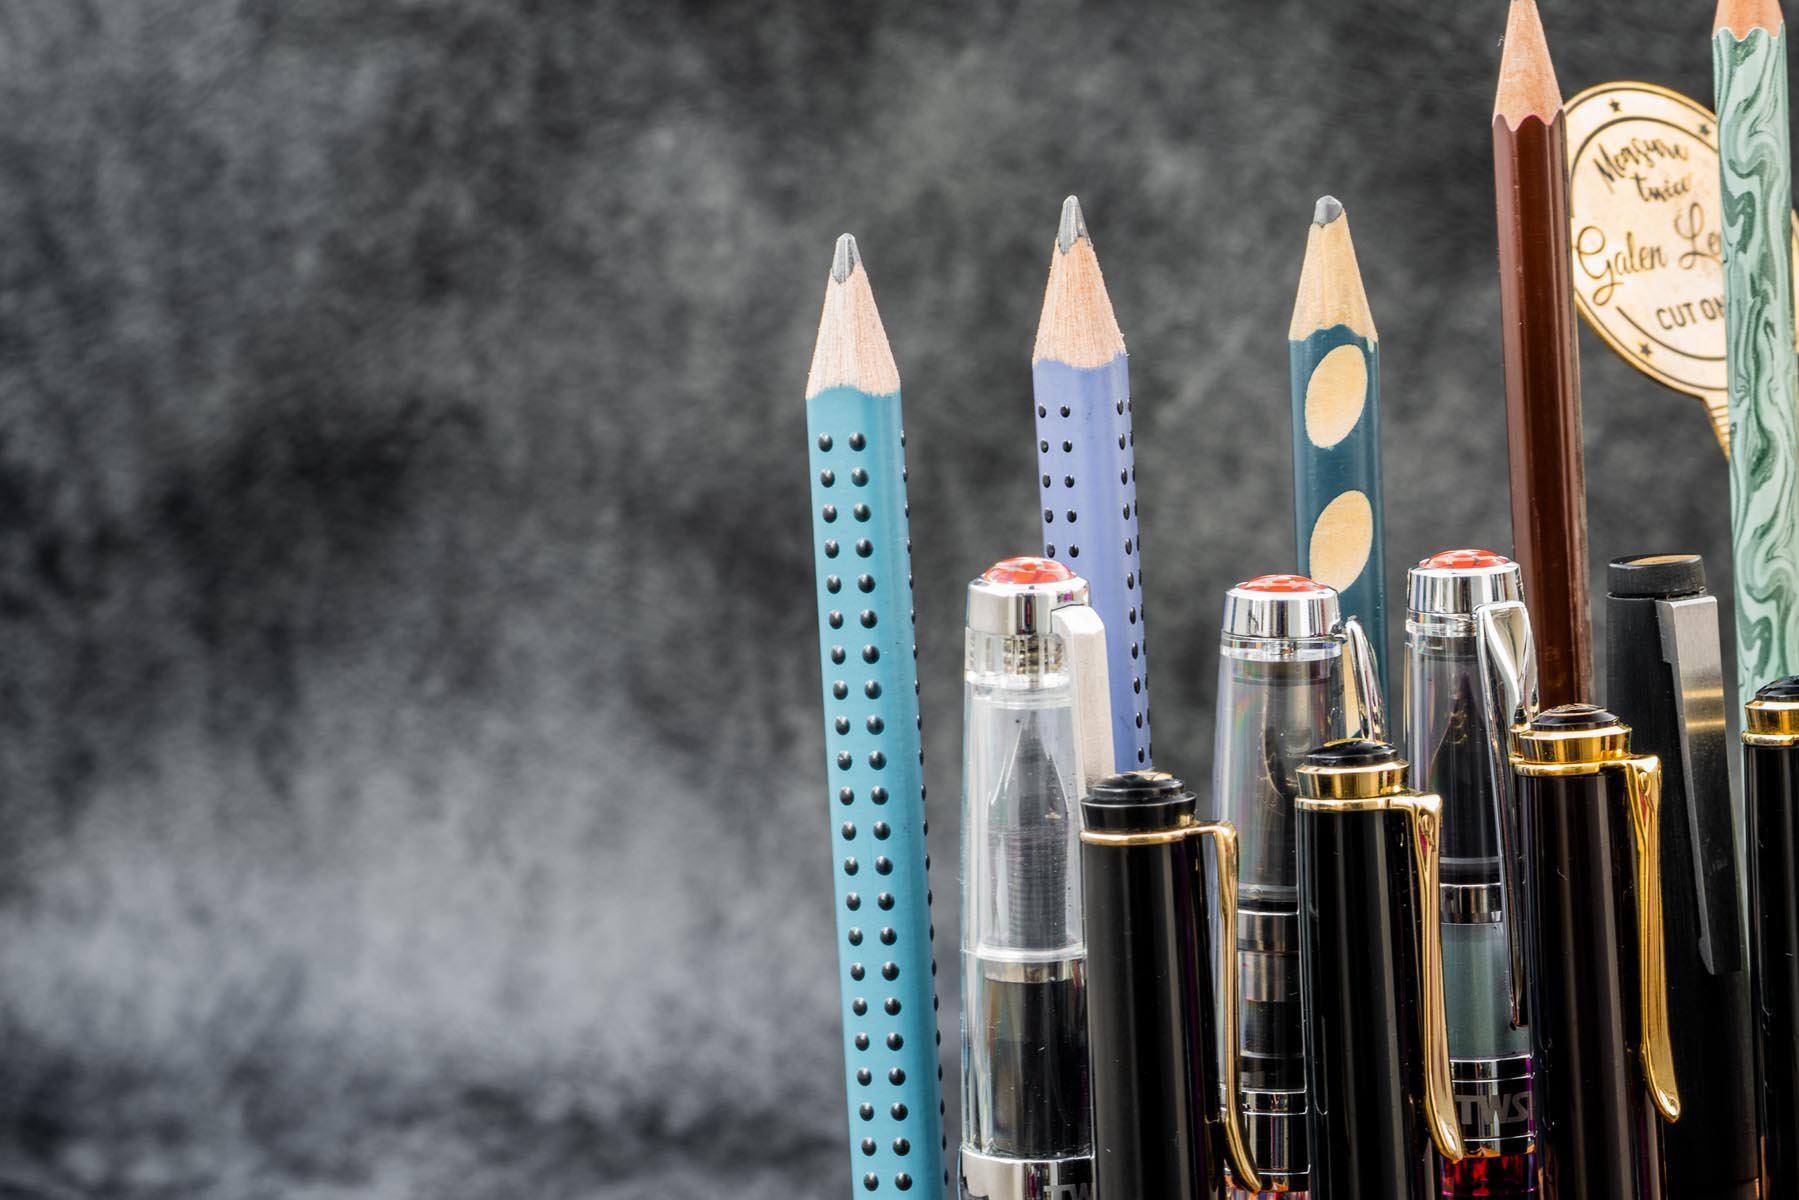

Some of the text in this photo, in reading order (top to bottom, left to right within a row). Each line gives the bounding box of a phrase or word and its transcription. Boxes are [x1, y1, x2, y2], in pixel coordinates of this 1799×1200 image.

[1593, 137, 1689, 194] Measure
[1630, 172, 1692, 202] twice
[1572, 225, 1668, 306] Galen
[1656, 302, 1697, 330] CUT
